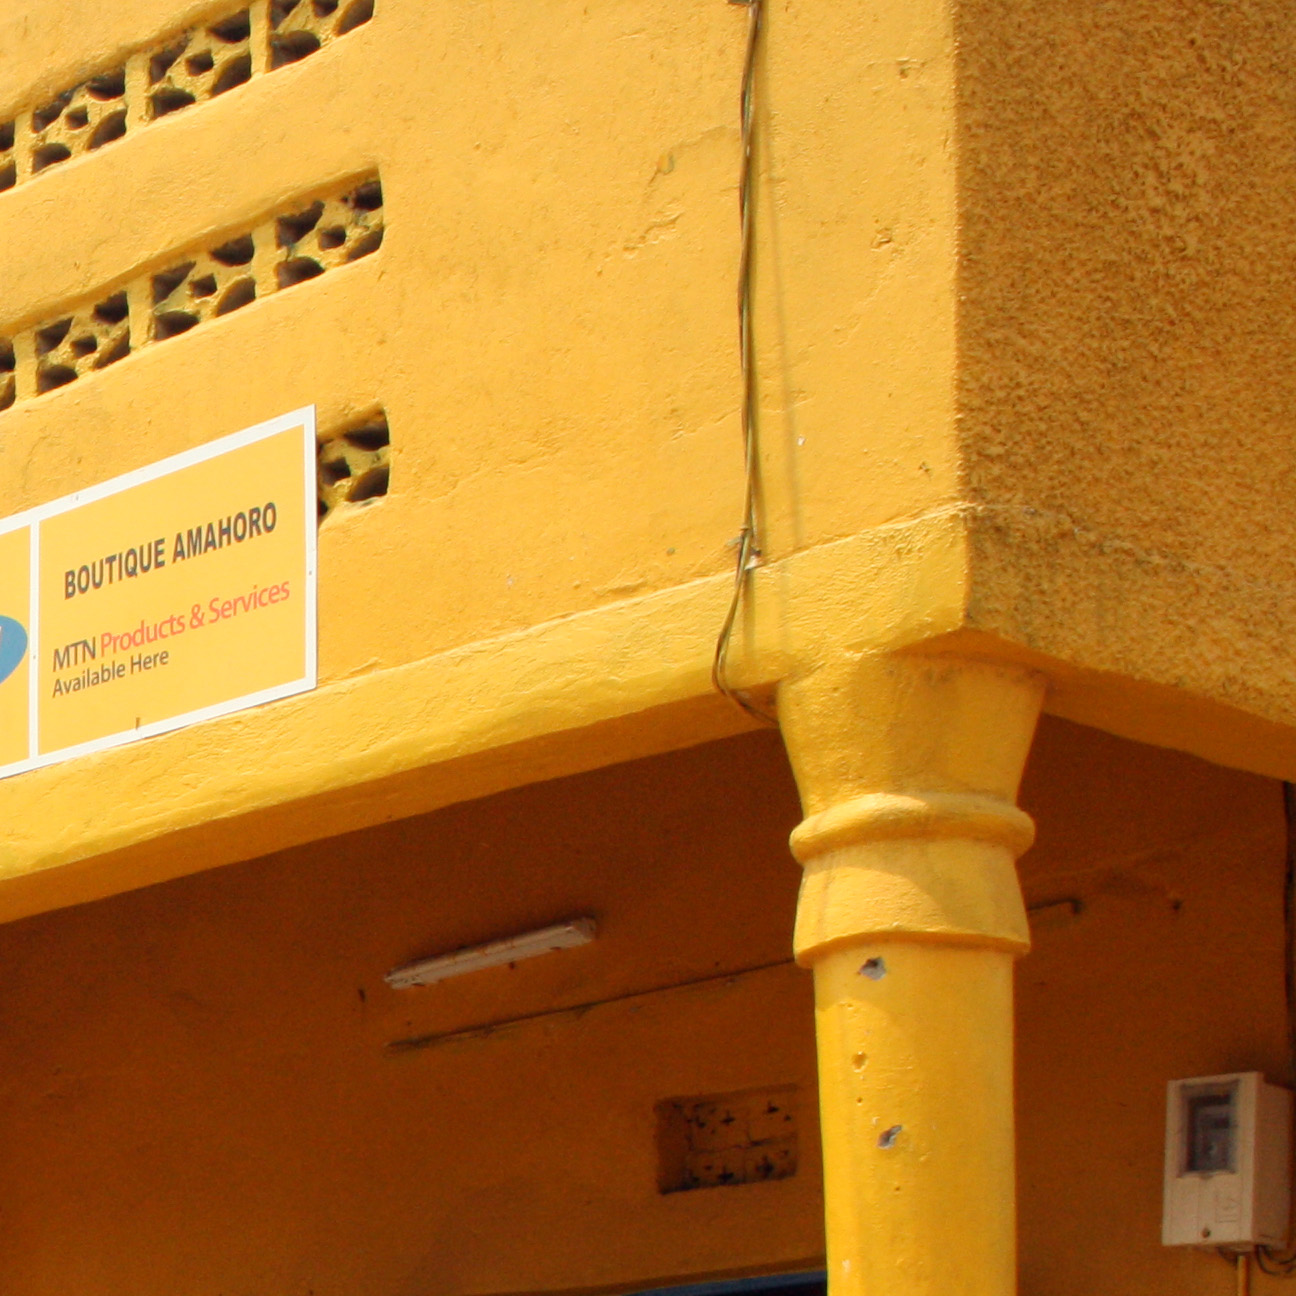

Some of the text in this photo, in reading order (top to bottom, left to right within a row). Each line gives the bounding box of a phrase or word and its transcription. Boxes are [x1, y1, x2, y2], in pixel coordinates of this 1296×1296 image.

[64, 502, 277, 600] BOUTIQUE AMAHORO
[52, 580, 291, 673] MTN Products & Services
[52, 650, 169, 698] Available Here
